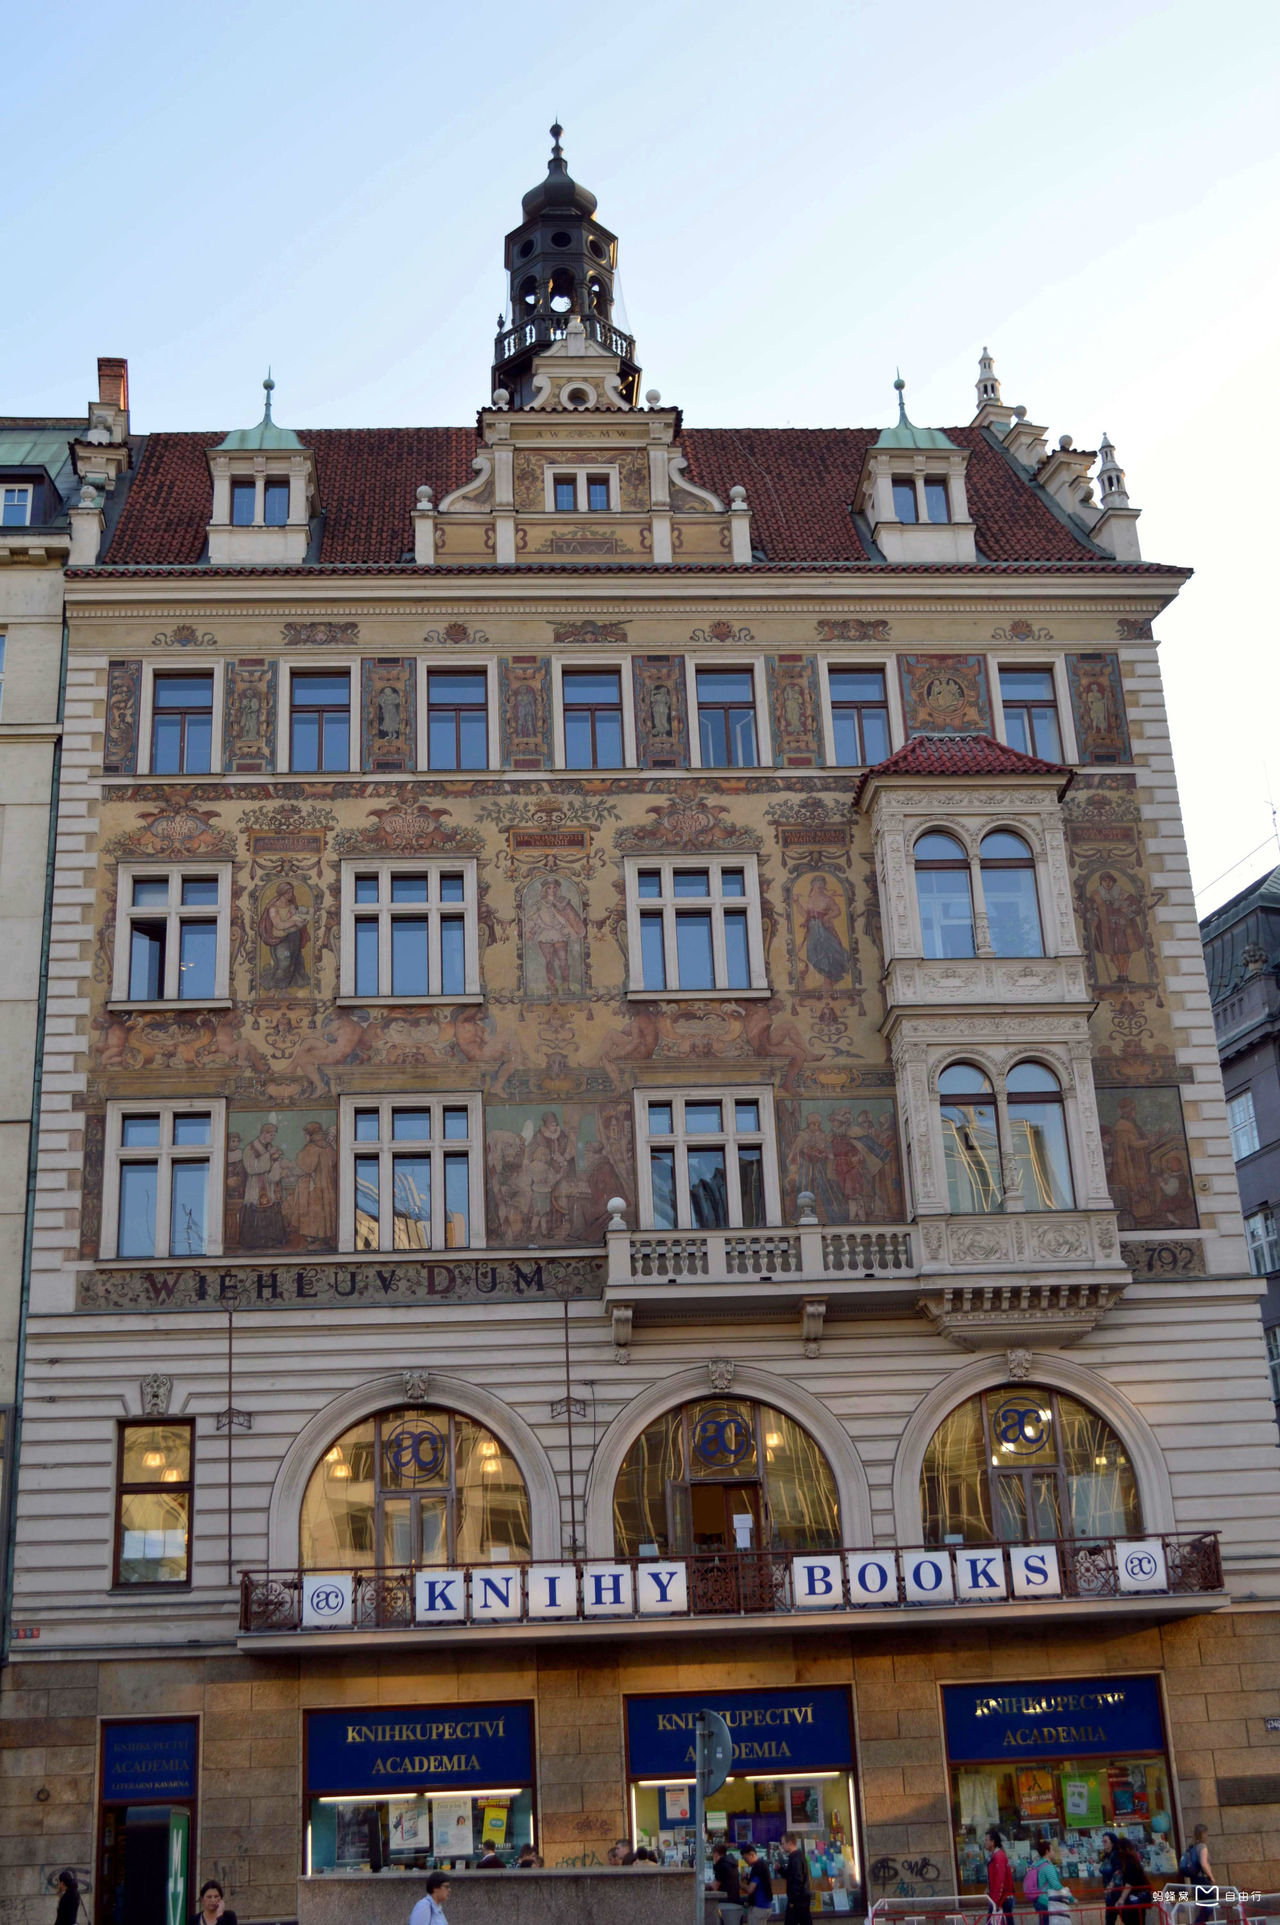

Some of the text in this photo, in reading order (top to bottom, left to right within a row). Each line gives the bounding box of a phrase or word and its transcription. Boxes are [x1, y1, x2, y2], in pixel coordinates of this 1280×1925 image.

[1144, 1247, 1195, 1275] 792
[424, 1554, 1049, 1612] KNIHY BOOKS
[346, 1716, 505, 1743] KNIHKUPECTVÍ
[657, 1703, 814, 1731] KNIUPECTVÍ
[1003, 1725, 1108, 1746] ACADEMIA
[371, 1754, 481, 1775] ACADEMIA
[684, 1740, 792, 1762] AEMIA
